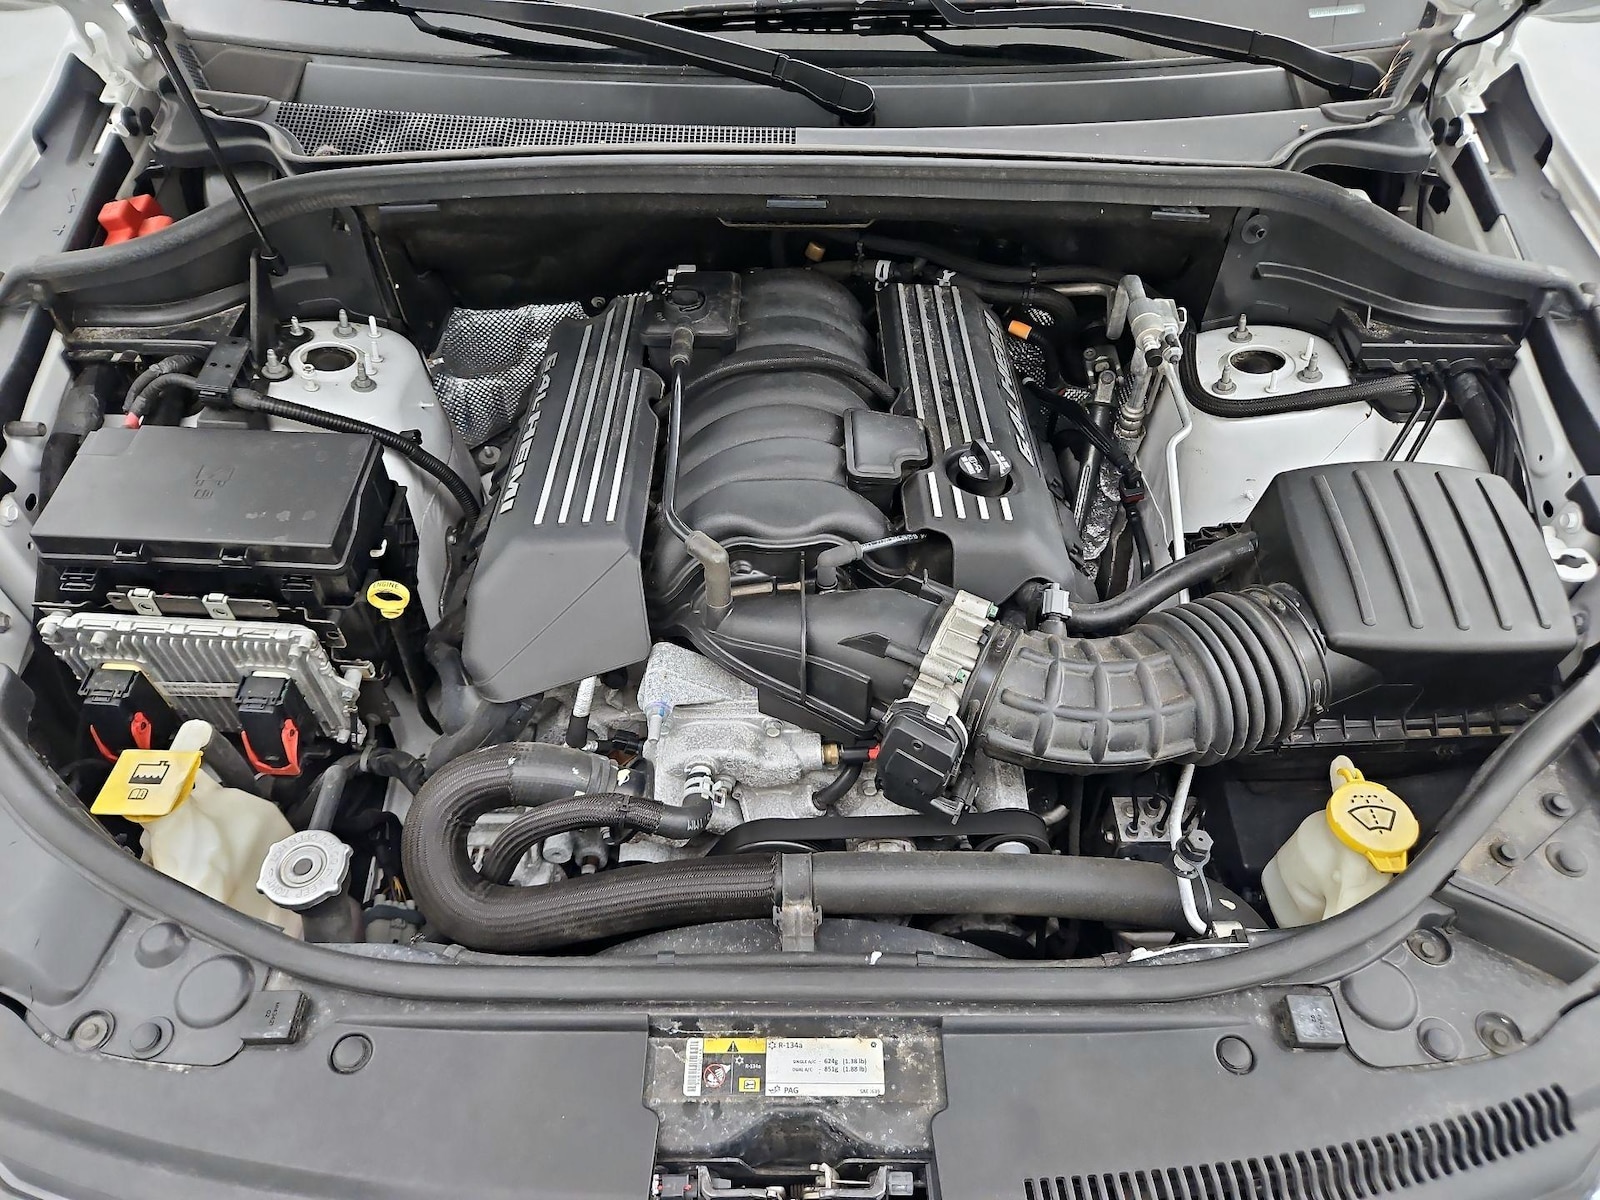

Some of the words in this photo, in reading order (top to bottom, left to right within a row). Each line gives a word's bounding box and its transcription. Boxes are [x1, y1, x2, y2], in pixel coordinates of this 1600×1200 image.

[984, 309, 1016, 401] HEMI
[500, 410, 541, 514] HEMI
[372, 581, 399, 590] ENGINE
[778, 1041, 803, 1049] R-134a
[823, 1058, 838, 1066] 624g
[783, 1086, 799, 1094] PAG
